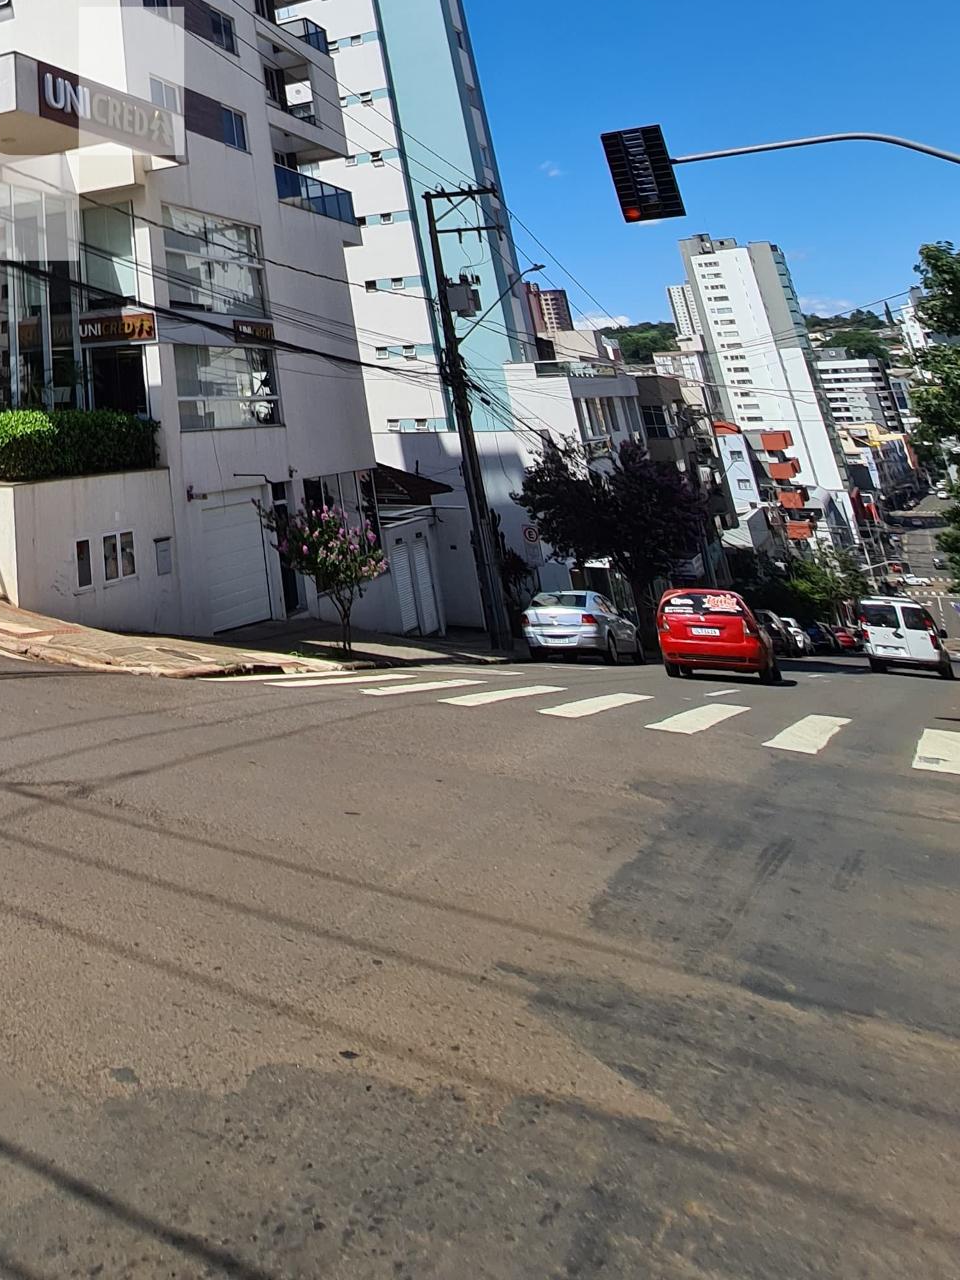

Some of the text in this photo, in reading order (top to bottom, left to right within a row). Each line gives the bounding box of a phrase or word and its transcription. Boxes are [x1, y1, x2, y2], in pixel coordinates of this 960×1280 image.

[44, 73, 146, 136] UNICRED
[78, 320, 134, 337] UNICRED
[528, 530, 535, 539] E
